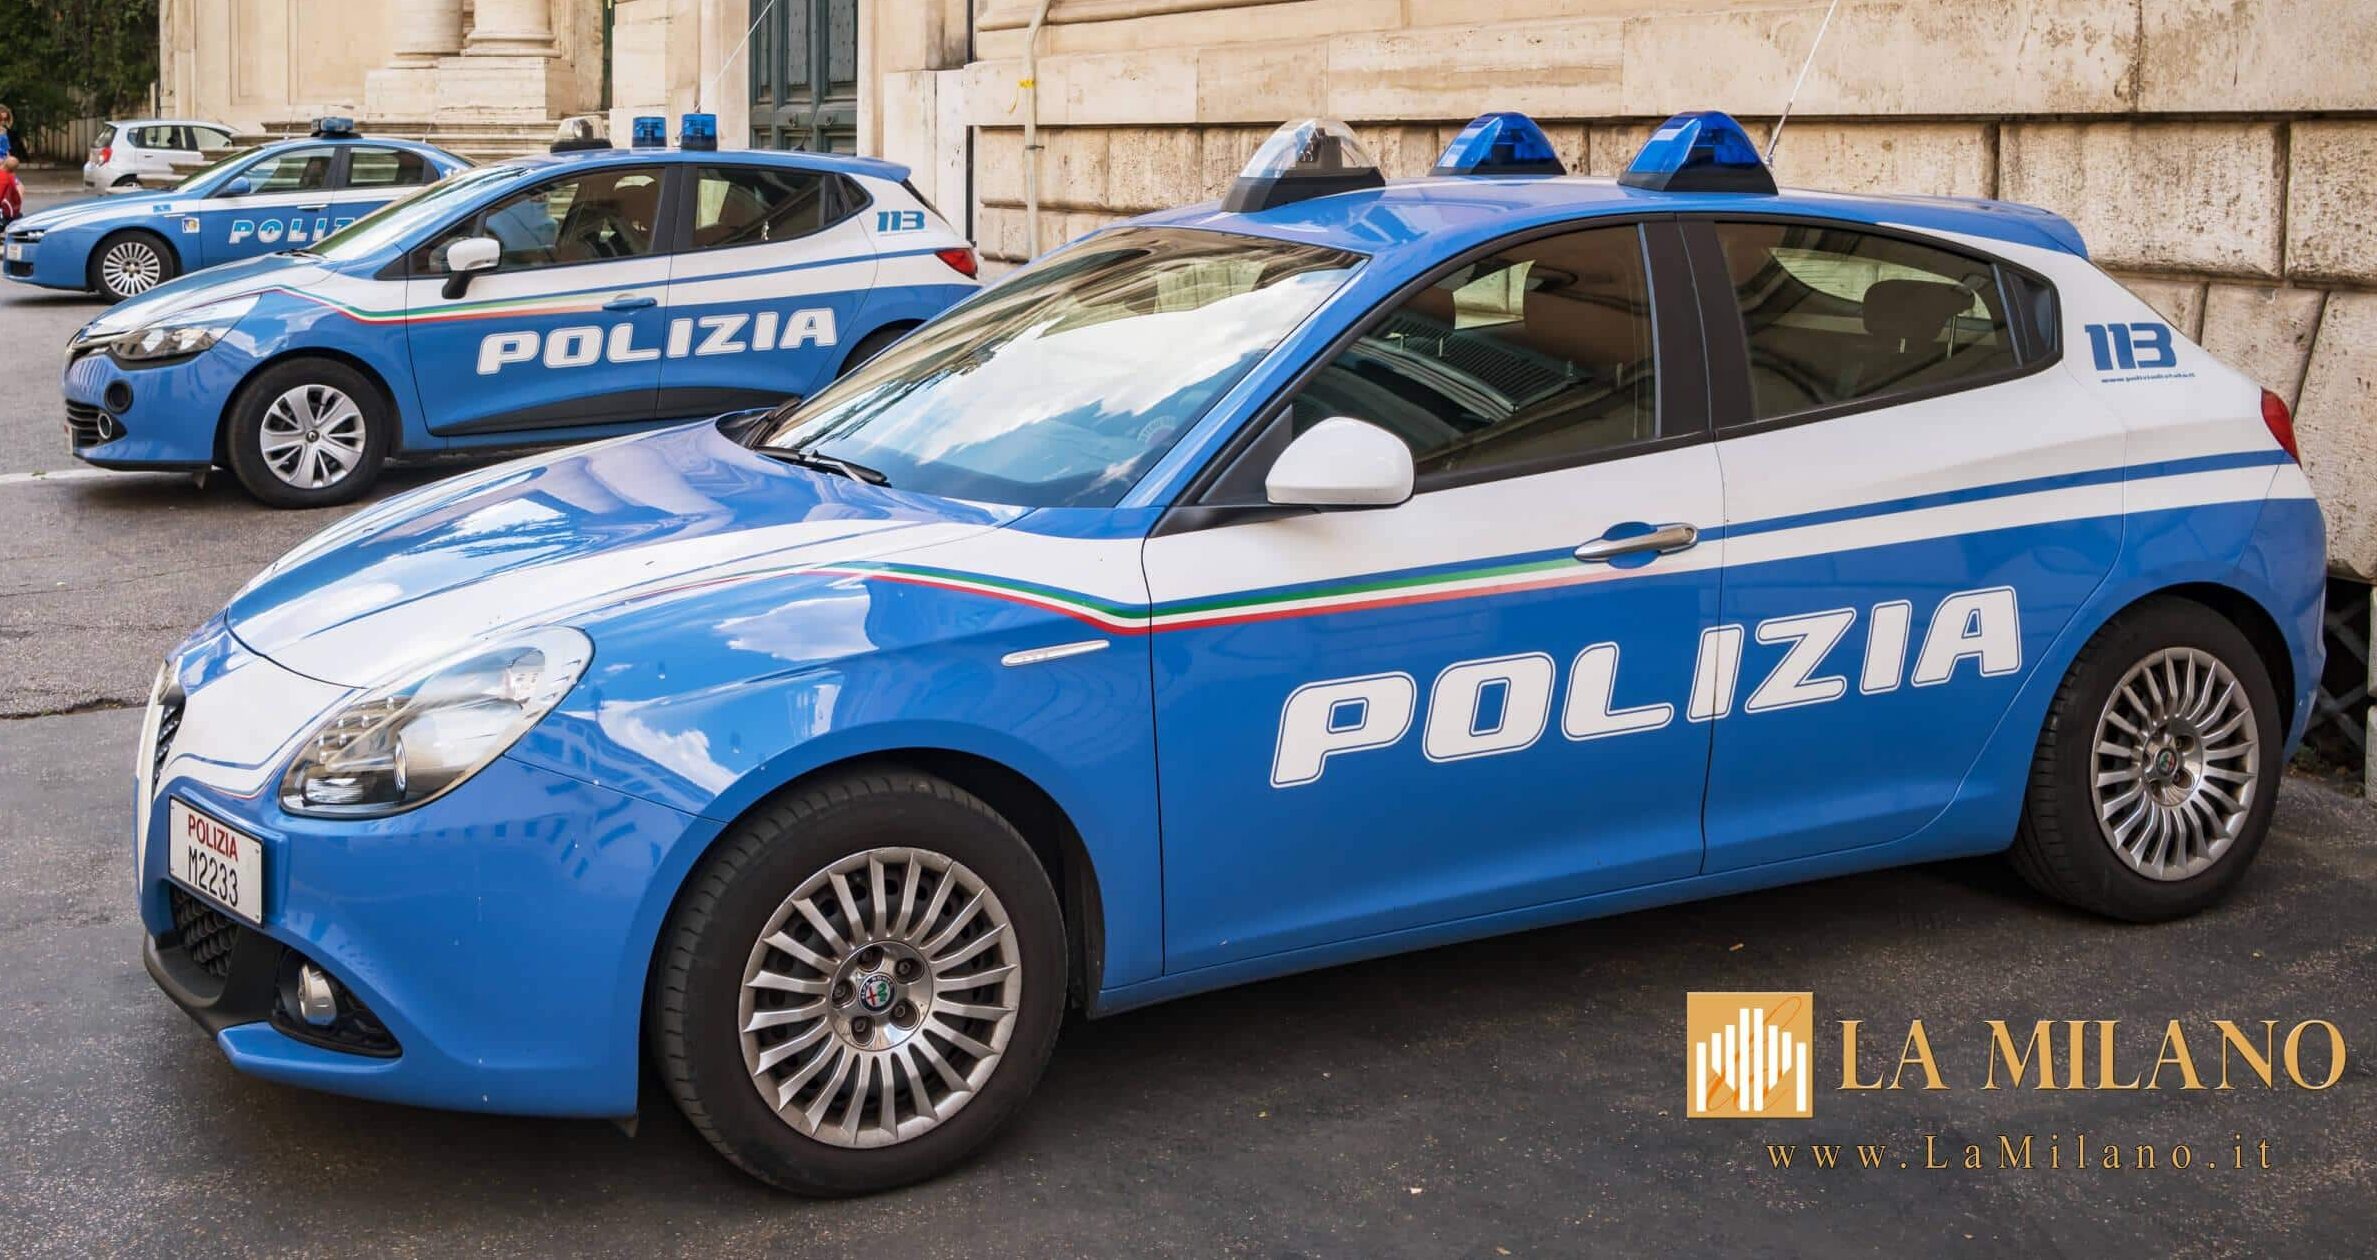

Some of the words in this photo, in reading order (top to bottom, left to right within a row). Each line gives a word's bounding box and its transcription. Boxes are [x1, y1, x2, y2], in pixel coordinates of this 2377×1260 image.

[877, 210, 925, 232] 113
[476, 307, 838, 376] POLIZIA
[2084, 322, 2177, 371] 113
[1270, 585, 2022, 789] POLIZIA
[188, 813, 239, 862] POLIZIA
[188, 845, 239, 907] M2233
